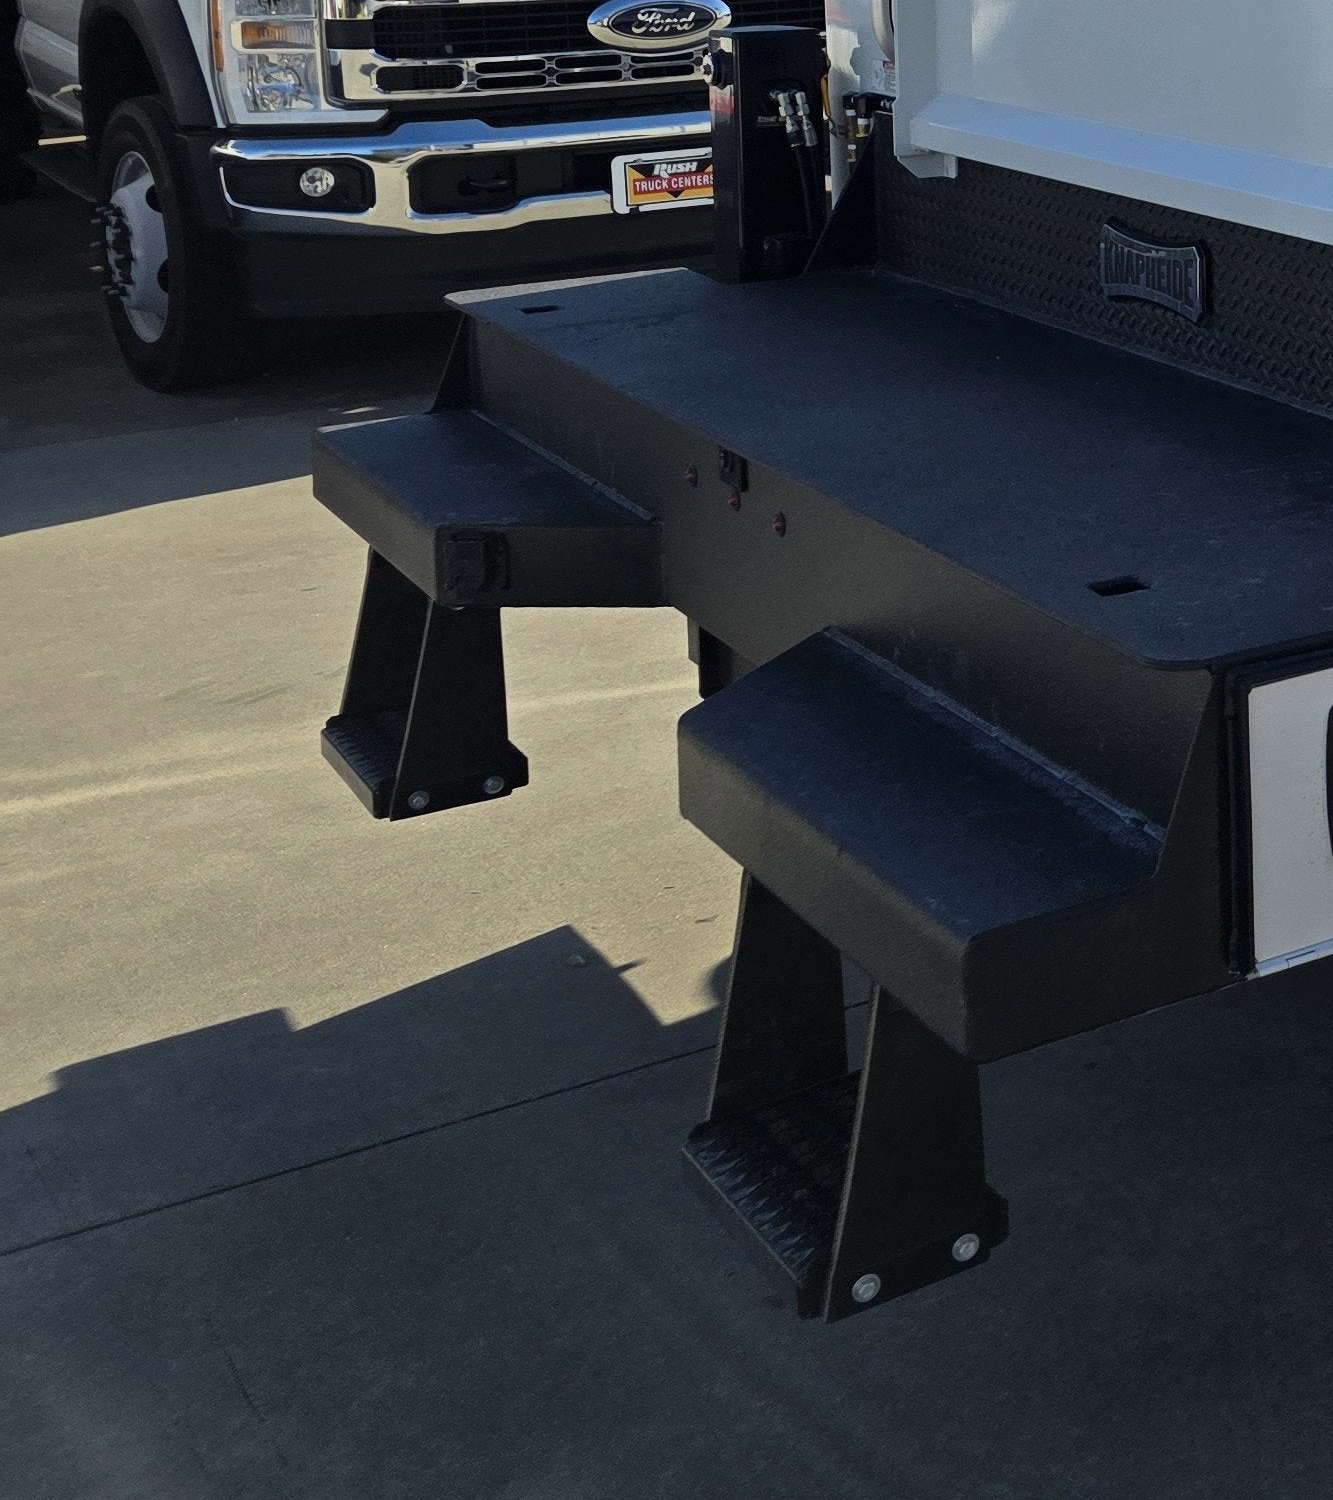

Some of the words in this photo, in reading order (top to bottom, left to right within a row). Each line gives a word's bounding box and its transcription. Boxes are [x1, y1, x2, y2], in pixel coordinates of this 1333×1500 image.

[632, 8, 696, 34] Ford
[653, 162, 698, 179] RUSH
[635, 179, 668, 192] TRUCK
[672, 174, 713, 188] CENTERS
